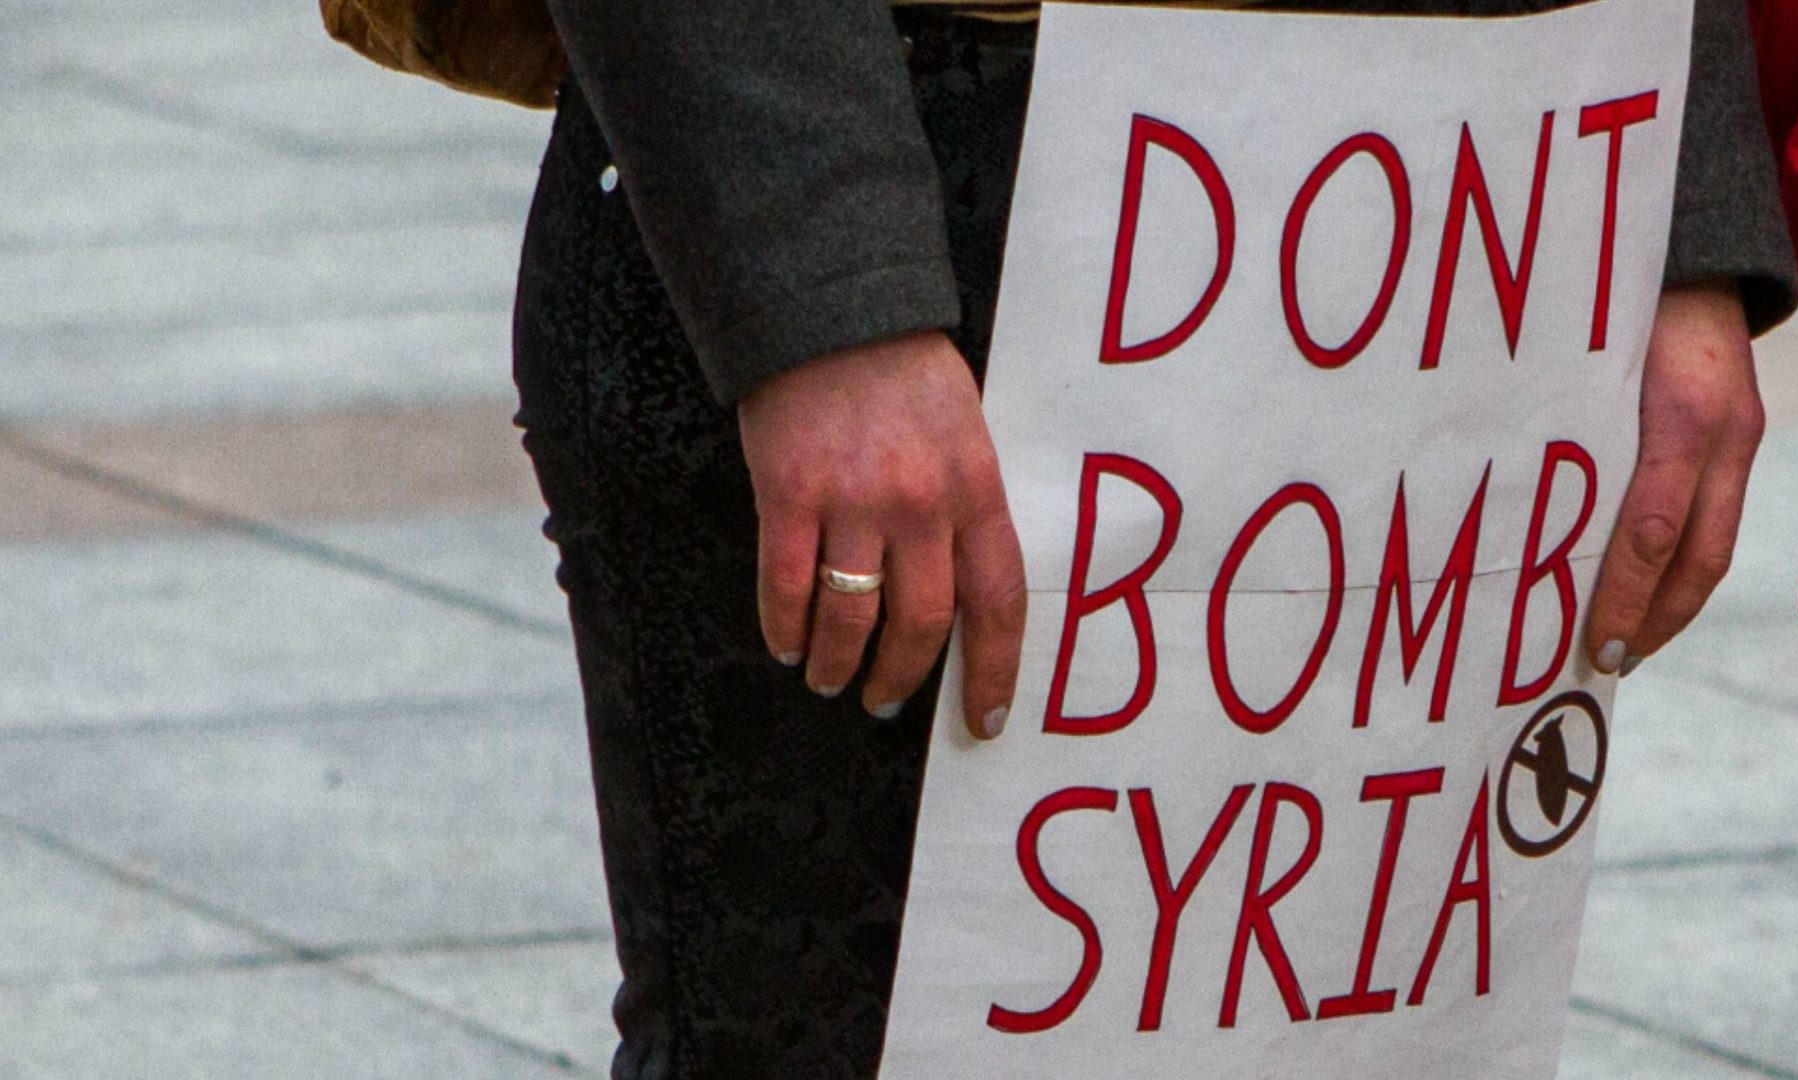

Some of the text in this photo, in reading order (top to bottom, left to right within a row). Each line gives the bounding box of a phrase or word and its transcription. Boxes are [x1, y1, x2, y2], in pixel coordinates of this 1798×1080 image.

[1100, 91, 1659, 369] DONT
[1043, 441, 1597, 735] BOMB
[987, 768, 1490, 1033] SYRIA
